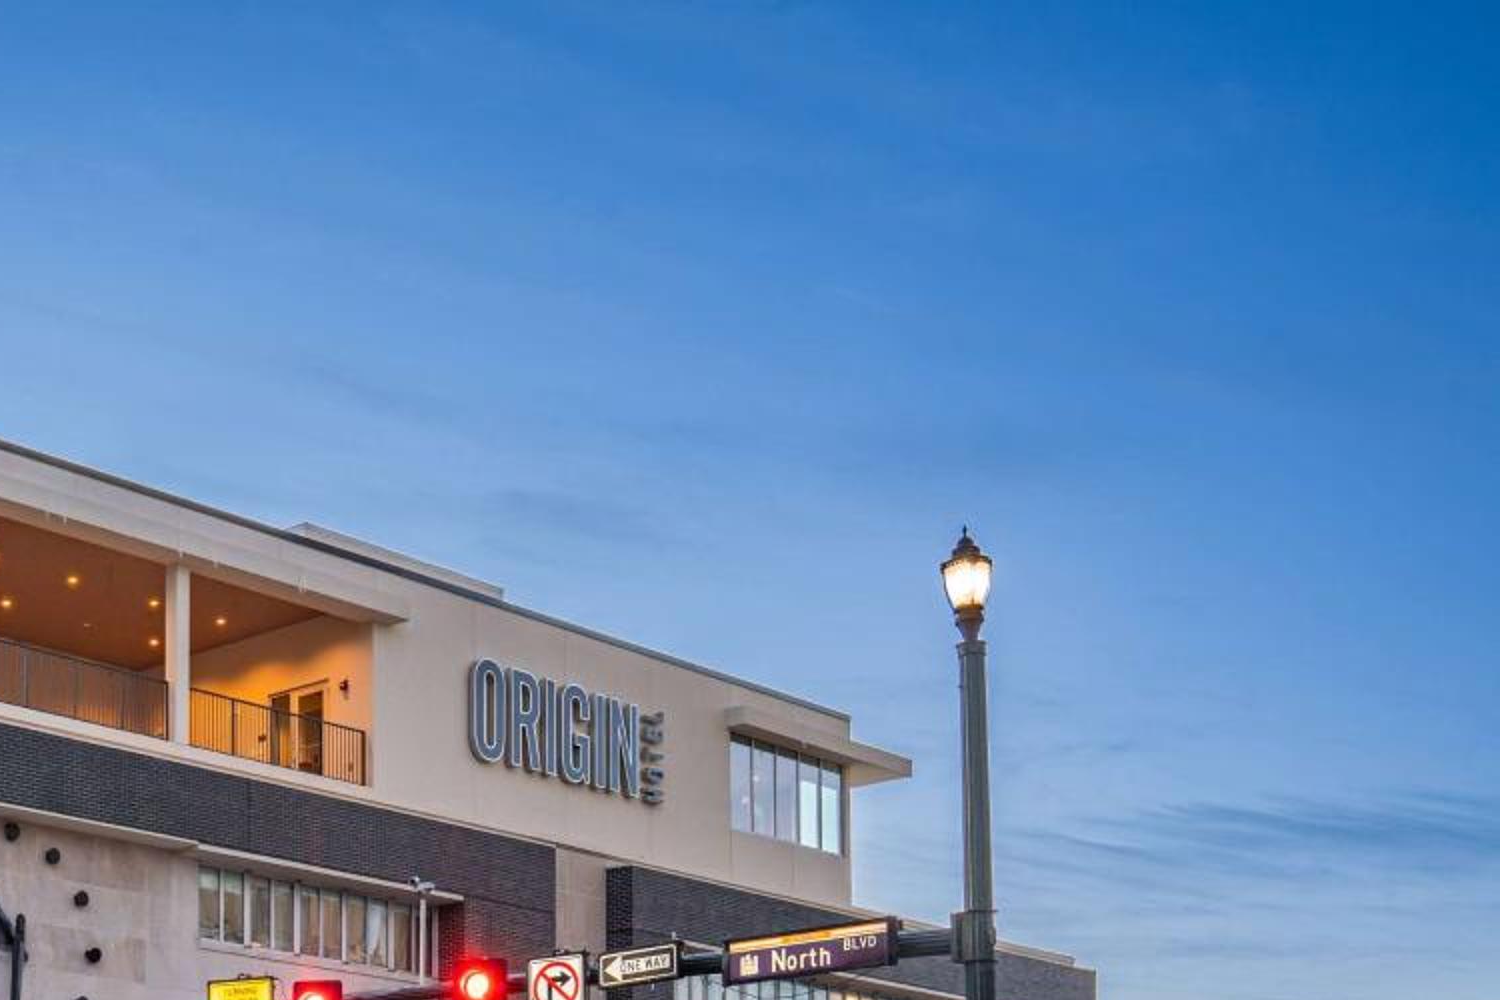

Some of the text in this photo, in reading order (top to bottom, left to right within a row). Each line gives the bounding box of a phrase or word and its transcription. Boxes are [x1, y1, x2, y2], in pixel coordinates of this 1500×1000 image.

[469, 657, 640, 799] ORIGIN
[639, 711, 665, 805] HOTEL
[620, 953, 668, 973] ONE WAY
[771, 935, 877, 973] North BLVD
